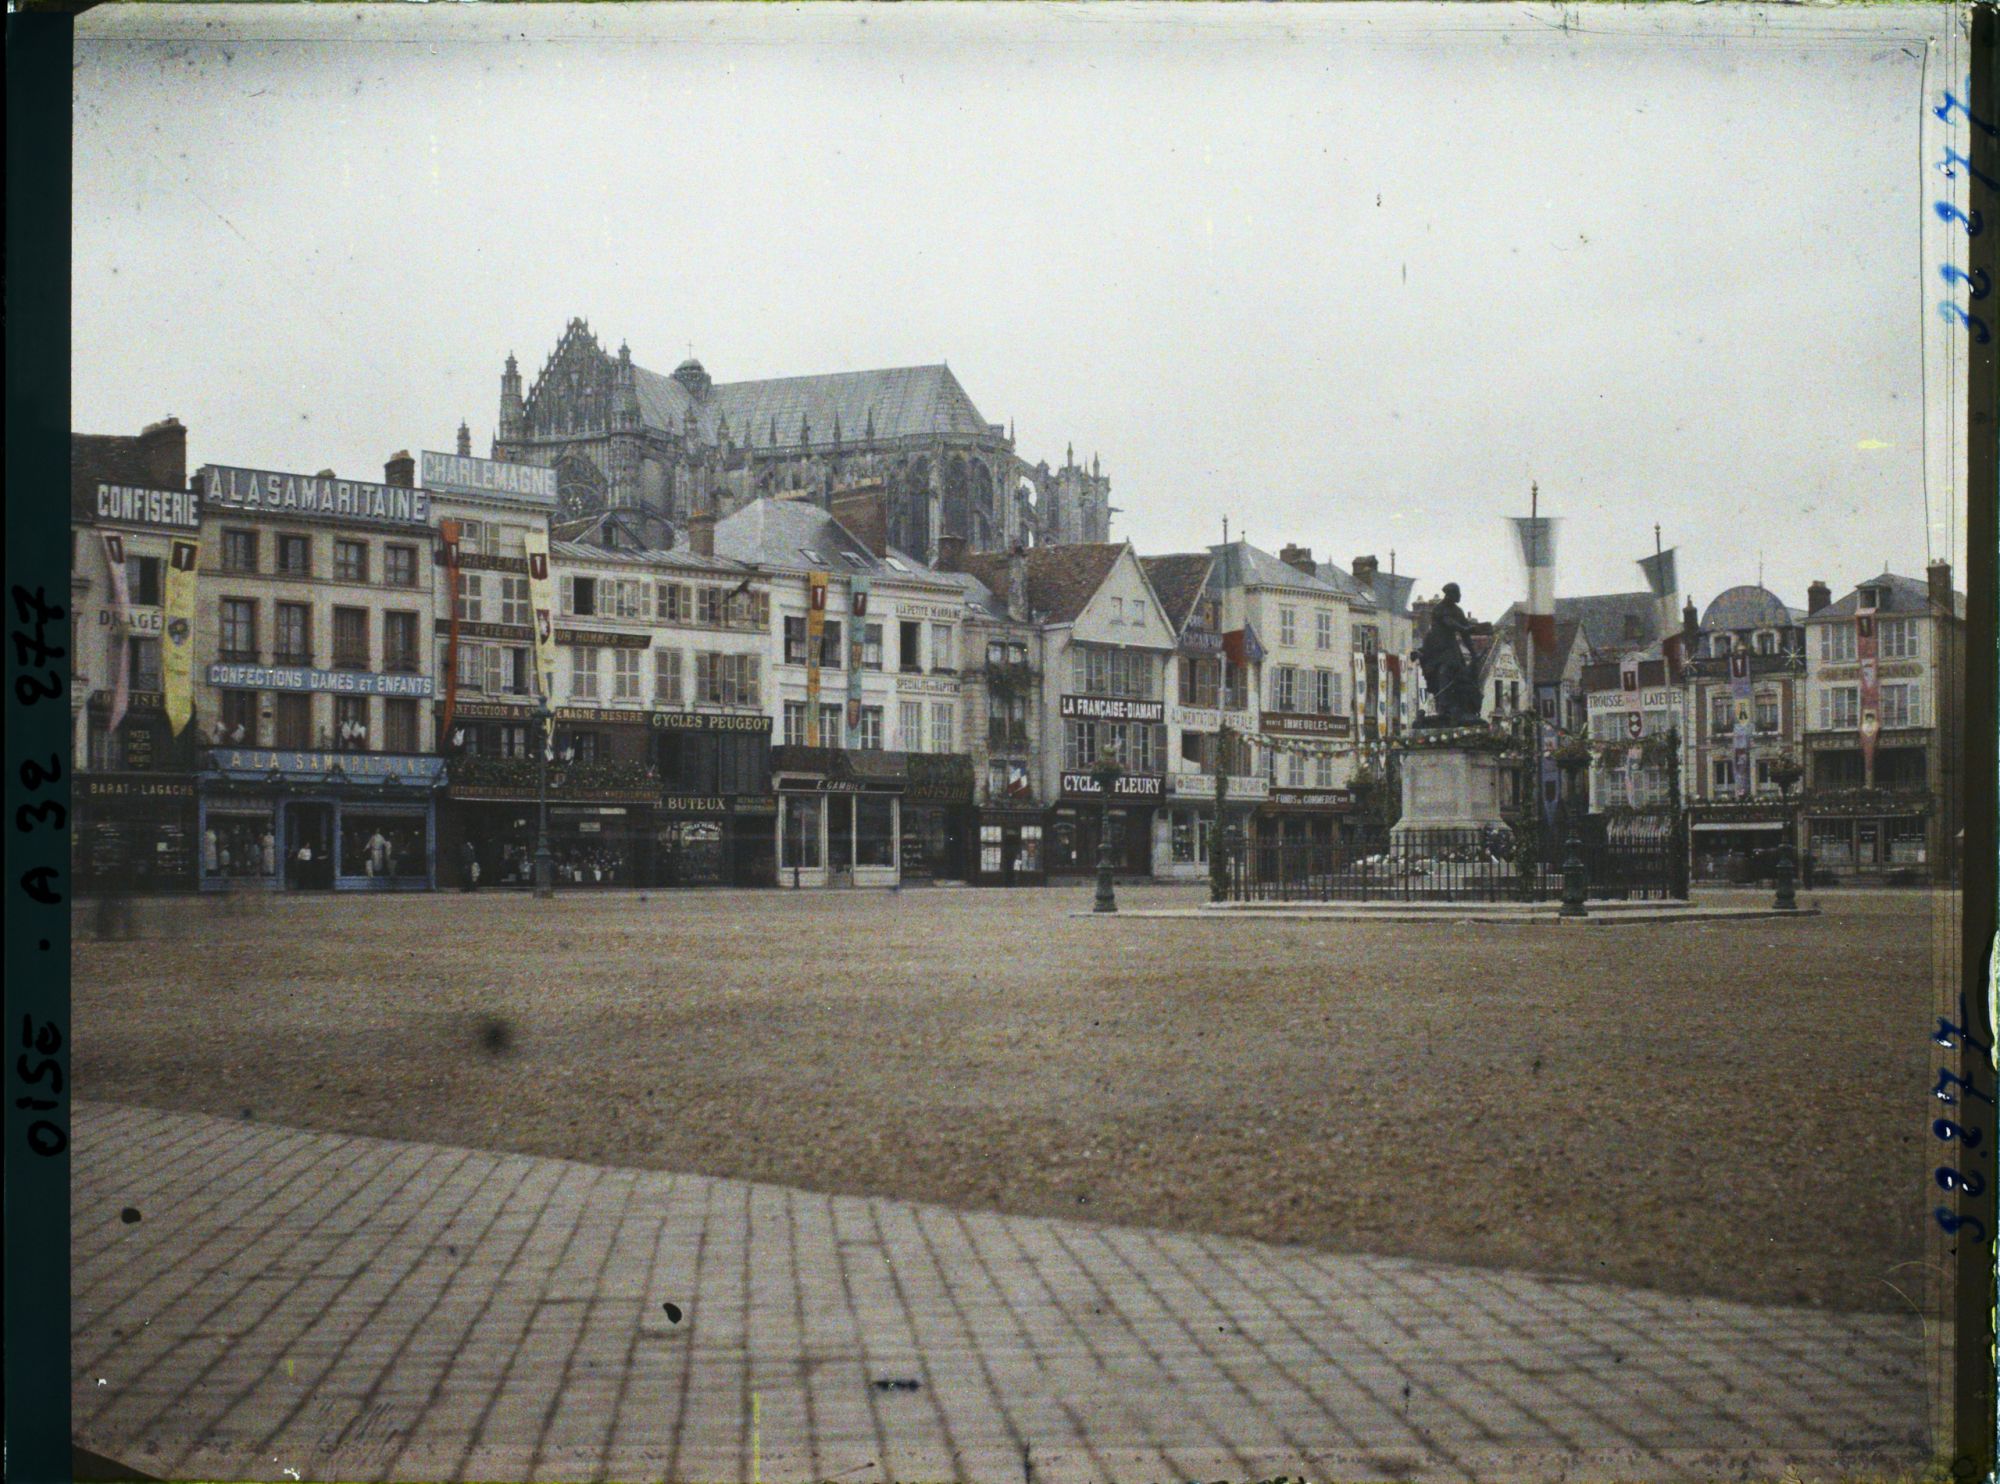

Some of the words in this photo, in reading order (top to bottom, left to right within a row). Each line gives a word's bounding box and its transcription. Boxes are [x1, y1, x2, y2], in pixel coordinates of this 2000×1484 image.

[423, 452, 554, 496] CHARLEMAGNE
[97, 484, 199, 525] CONFISERIE
[267, 475, 427, 521] SAMARITAINE
[211, 665, 302, 688] CONFECTIONS
[311, 670, 353, 691] DAMES
[377, 675, 432, 695] ENFANTS
[1062, 698, 1075, 714] LA
[600, 711, 644, 722] MESURE
[652, 714, 702, 729] CYCLES
[708, 716, 770, 731] PEUGEOT
[1283, 719, 1329, 731] IMMEUBLES
[231, 752, 241, 767] A
[1114, 777, 1162, 794] FLEURY
[668, 797, 726, 810] BUTEUX
[21, 866, 62, 904] A
